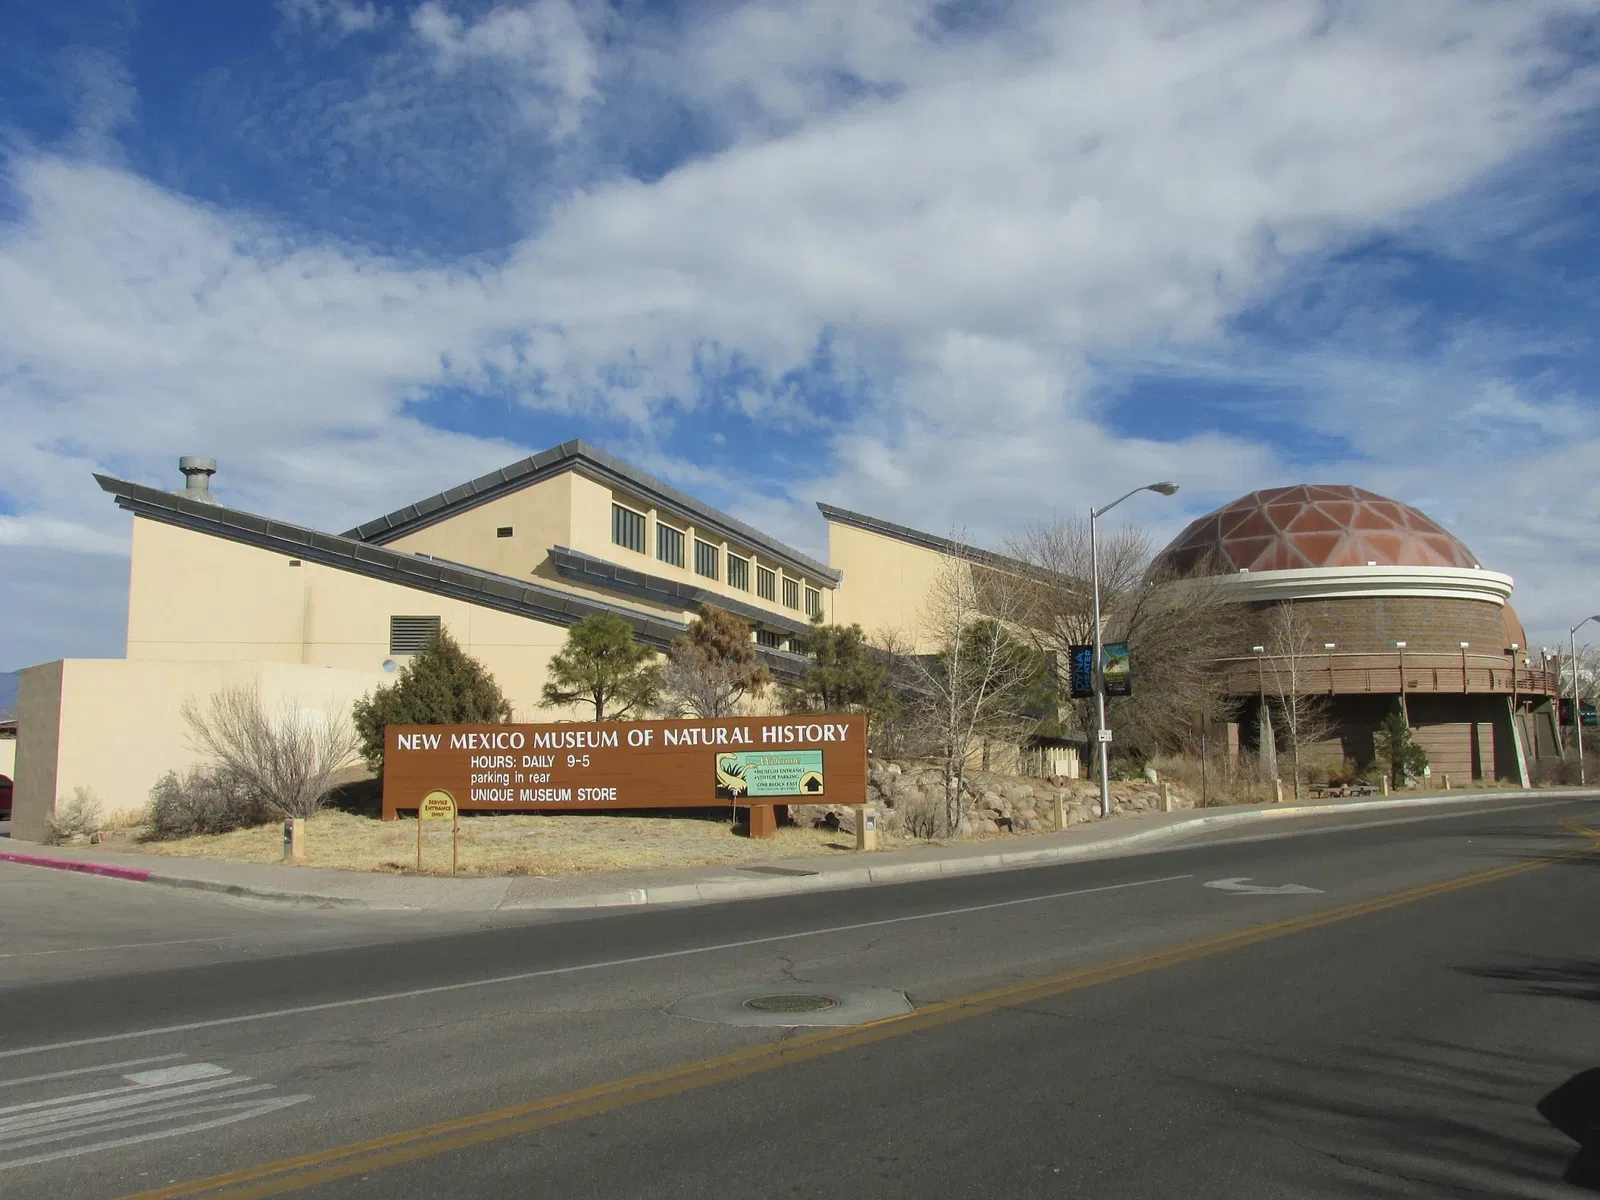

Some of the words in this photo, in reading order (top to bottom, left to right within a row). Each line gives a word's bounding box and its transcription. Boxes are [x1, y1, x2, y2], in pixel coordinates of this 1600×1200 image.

[1075, 652, 1084, 691] DYNA
[1084, 650, 1092, 692] THEATER
[398, 733, 442, 750] NEW
[450, 732, 525, 749] MEXICO
[533, 730, 619, 748] MUSEUM
[627, 729, 653, 747] OF
[664, 726, 753, 746] NATURAL
[762, 724, 850, 743] HISTORY
[471, 755, 517, 768] HOURS:
[522, 754, 555, 768] DAILY
[567, 754, 590, 767] 9-5
[760, 756, 800, 765] Welcome
[471, 771, 510, 785] parking
[515, 771, 524, 782] in
[529, 773, 550, 783] rear
[471, 789, 514, 802] UNIQUE
[520, 788, 572, 801] MUSEUM
[577, 788, 617, 800] STORE
